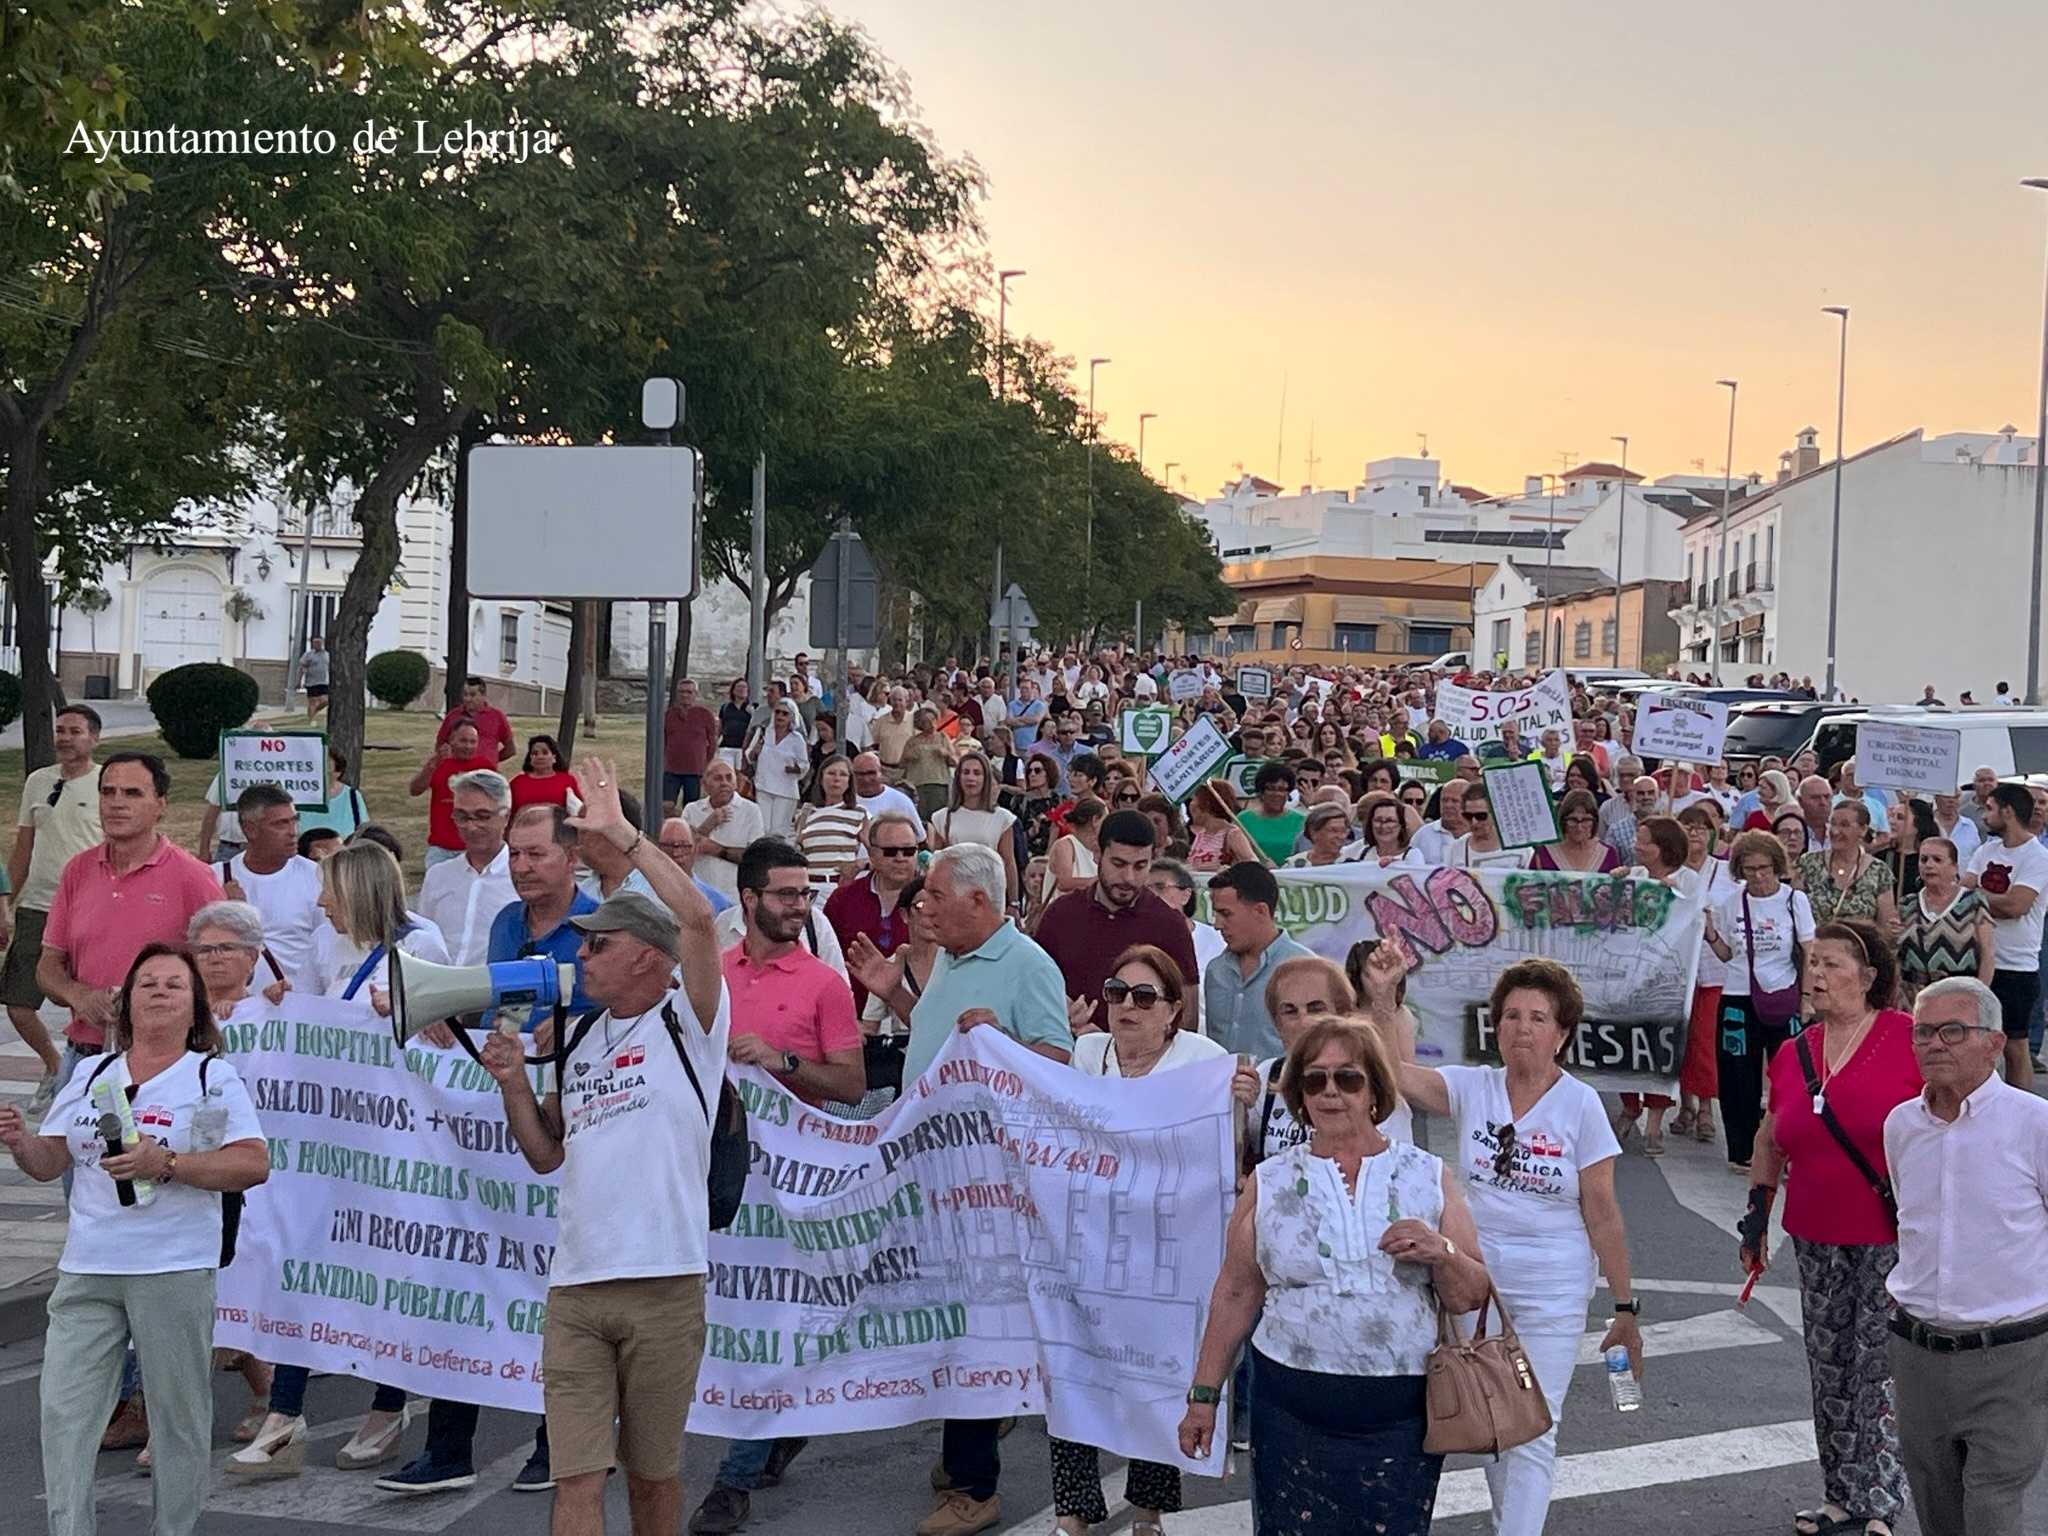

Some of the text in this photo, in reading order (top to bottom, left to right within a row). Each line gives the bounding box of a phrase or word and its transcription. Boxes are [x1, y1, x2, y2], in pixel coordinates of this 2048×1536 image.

[1547, 709, 1565, 726] YA
[234, 760, 314, 773] RECORTES
[260, 739, 287, 753] NO
[1163, 733, 1212, 781] RECORTES
[1167, 740, 1222, 793] SANITARIOS
[1171, 739, 1188, 757] NO
[1867, 740, 1949, 757] URGENCIAS EN
[1872, 753, 1942, 769] EL HOSPITAL
[230, 778, 320, 791] SANRIOS
[1275, 886, 1348, 922] ALUD
[1364, 866, 1499, 975] NO
[295, 1022, 396, 1069] HOSPITAL
[256, 1077, 324, 1116] SALUD
[330, 1086, 415, 1132] DIGNOS:
[878, 1110, 996, 1175] PERSONA
[1472, 1130, 1531, 1160] SANAD
[296, 1140, 470, 1200] HOSPITALARIAS
[369, 1213, 490, 1266] RECORTES
[496, 1235, 527, 1273] EN
[281, 1259, 378, 1307] SANIDAD
[383, 1275, 495, 1334] PÚBLICA,
[706, 1322, 783, 1365] ERSAL
[793, 1332, 810, 1368] Y
[817, 1324, 850, 1362] DE
[858, 1303, 968, 1350] CALIDAD
[216, 1307, 248, 1323] mas
[311, 1322, 372, 1352] Blancas
[418, 1345, 494, 1376] Defensa
[500, 1358, 526, 1381] de
[702, 1383, 725, 1406] de
[805, 1386, 836, 1405] Las
[842, 1377, 928, 1403] Cabezas,
[932, 1365, 951, 1389] El
[954, 1366, 1013, 1389] Cuervo
[1017, 1367, 1031, 1391] y
